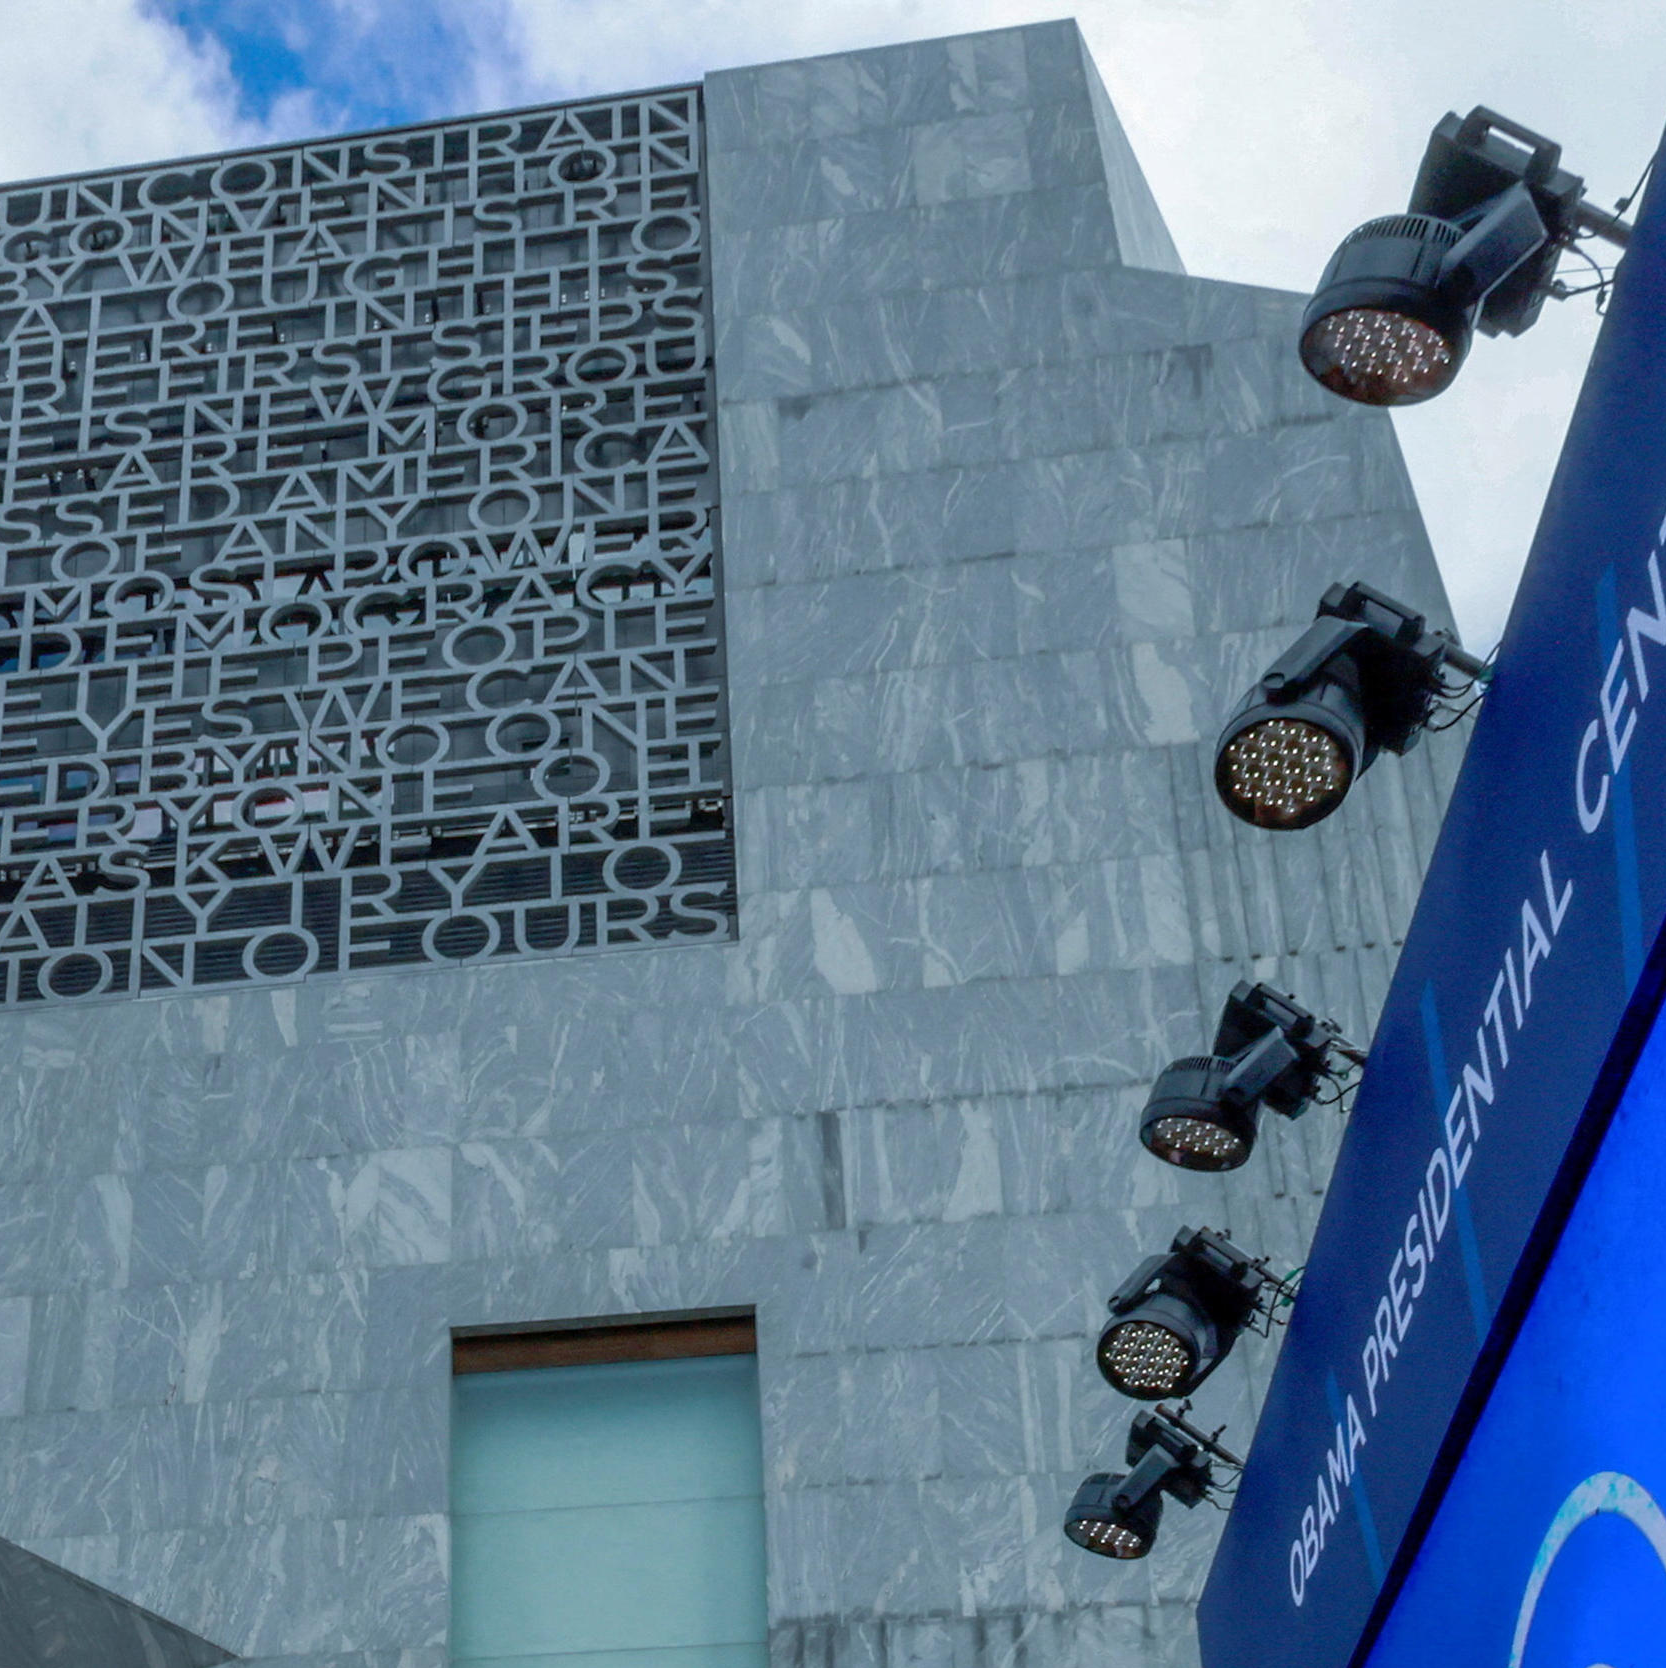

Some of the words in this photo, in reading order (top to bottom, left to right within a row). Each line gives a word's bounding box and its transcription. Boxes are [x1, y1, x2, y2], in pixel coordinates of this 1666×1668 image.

[115, 213, 398, 295] WHAT
[443, 195, 523, 249] IS
[565, 171, 692, 232] RE
[166, 231, 545, 327] OUGHT
[570, 209, 701, 271] TO
[158, 330, 413, 408] FIRST
[430, 291, 705, 371] STEPS
[324, 289, 415, 345] IN
[444, 253, 677, 328] THIS
[79, 405, 158, 459] IS
[183, 372, 403, 446] NEW
[426, 331, 707, 414] GROU
[102, 426, 307, 498] ARE
[367, 376, 688, 464] MORE
[49, 526, 186, 590] OF
[215, 496, 421, 569] ANY
[468, 461, 698, 537] ONE
[270, 416, 709, 519] AMERICA
[17, 549, 716, 681] DEMOCRACY
[21, 555, 298, 637] MOST
[334, 503, 712, 598] POWER
[54, 648, 262, 721] THE
[306, 596, 707, 692] PEOPLE
[72, 694, 258, 765] YES
[280, 673, 442, 741] WE
[466, 645, 686, 720] CAN
[138, 739, 269, 803] BY
[298, 718, 451, 786] NO
[485, 689, 717, 766] ONE
[533, 739, 700, 808] OH
[258, 816, 433, 887] WE
[473, 788, 691, 864] ARE
[267, 859, 488, 935] TRY
[527, 838, 682, 908] TO
[242, 918, 394, 989] OF
[422, 884, 730, 971] OURS
[1290, 1394, 1366, 1606] OBAMA
[1362, 849, 1572, 1417] PRESIDENTIAL
